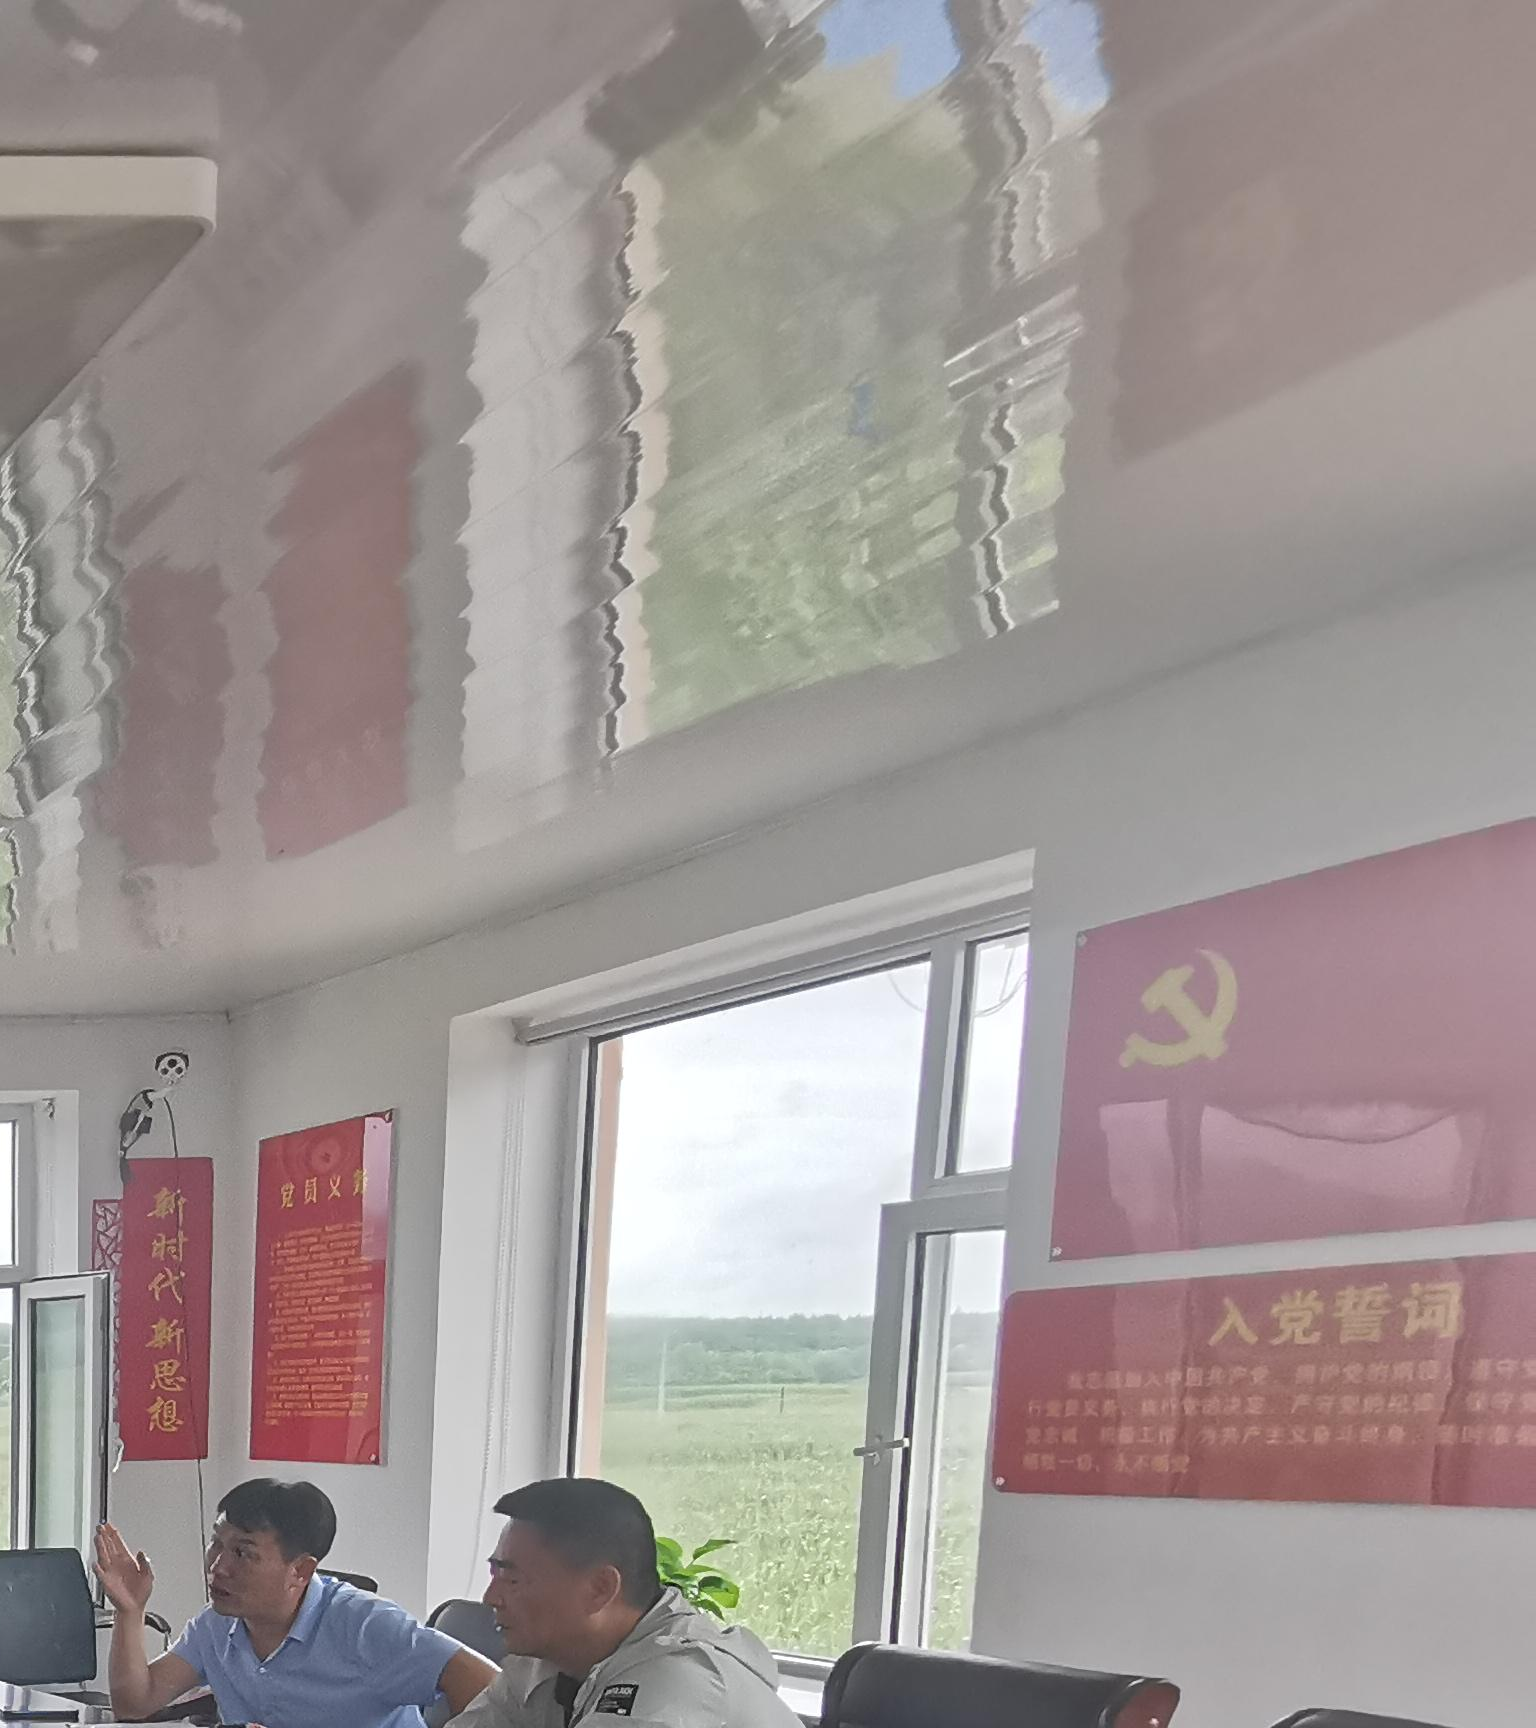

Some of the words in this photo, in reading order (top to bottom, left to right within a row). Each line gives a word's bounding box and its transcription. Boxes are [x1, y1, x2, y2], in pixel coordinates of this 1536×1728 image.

[146, 1186, 188, 1433] 新时代新思想
[1208, 1281, 1465, 1348] 入党誓词
